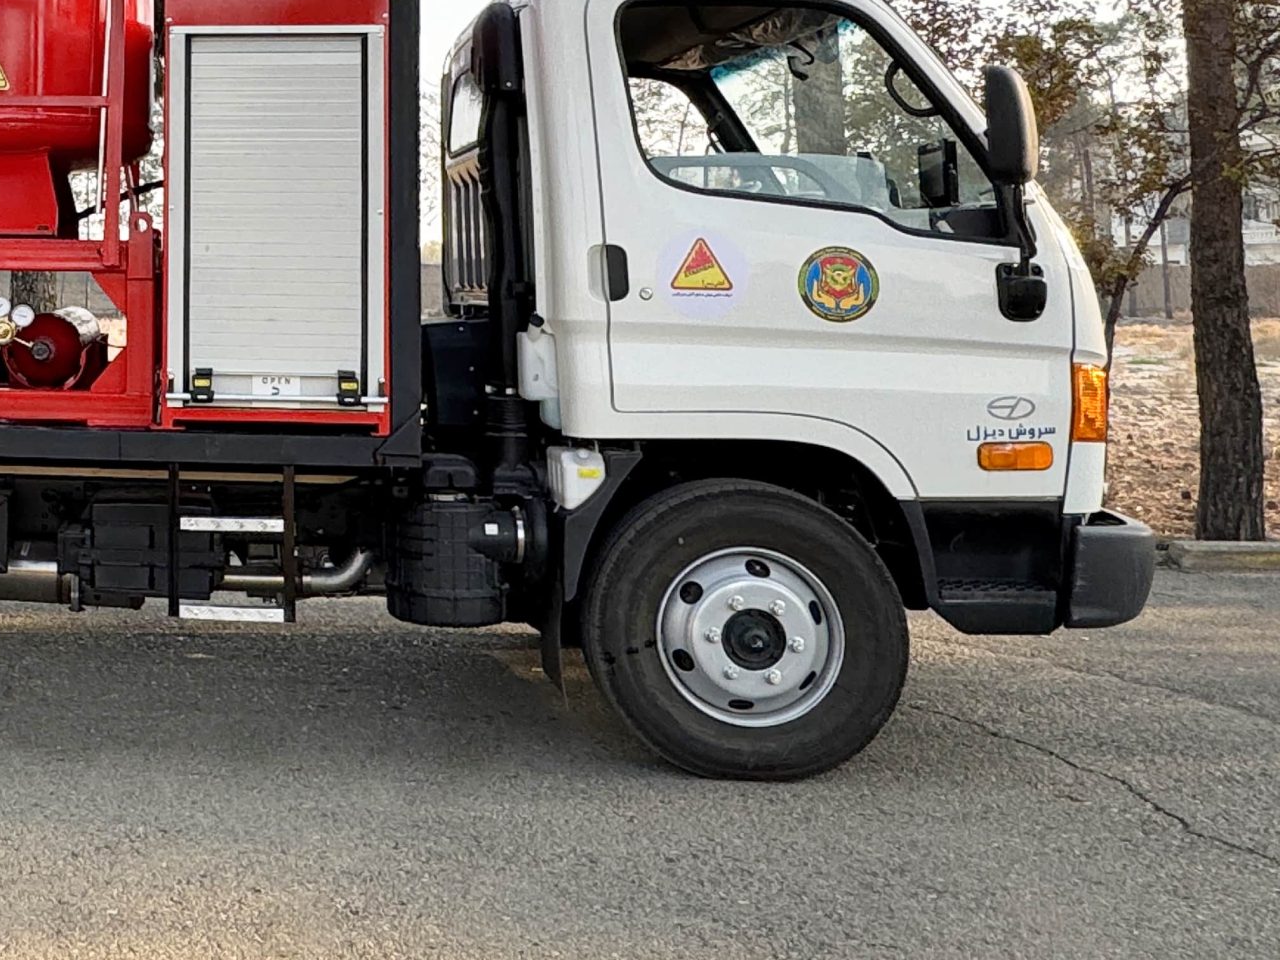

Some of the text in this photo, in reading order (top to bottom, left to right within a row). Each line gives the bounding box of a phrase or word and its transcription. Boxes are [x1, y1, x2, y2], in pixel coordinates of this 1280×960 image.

[261, 376, 291, 385] OPEN
[966, 423, 1056, 441] سروش دیزل
